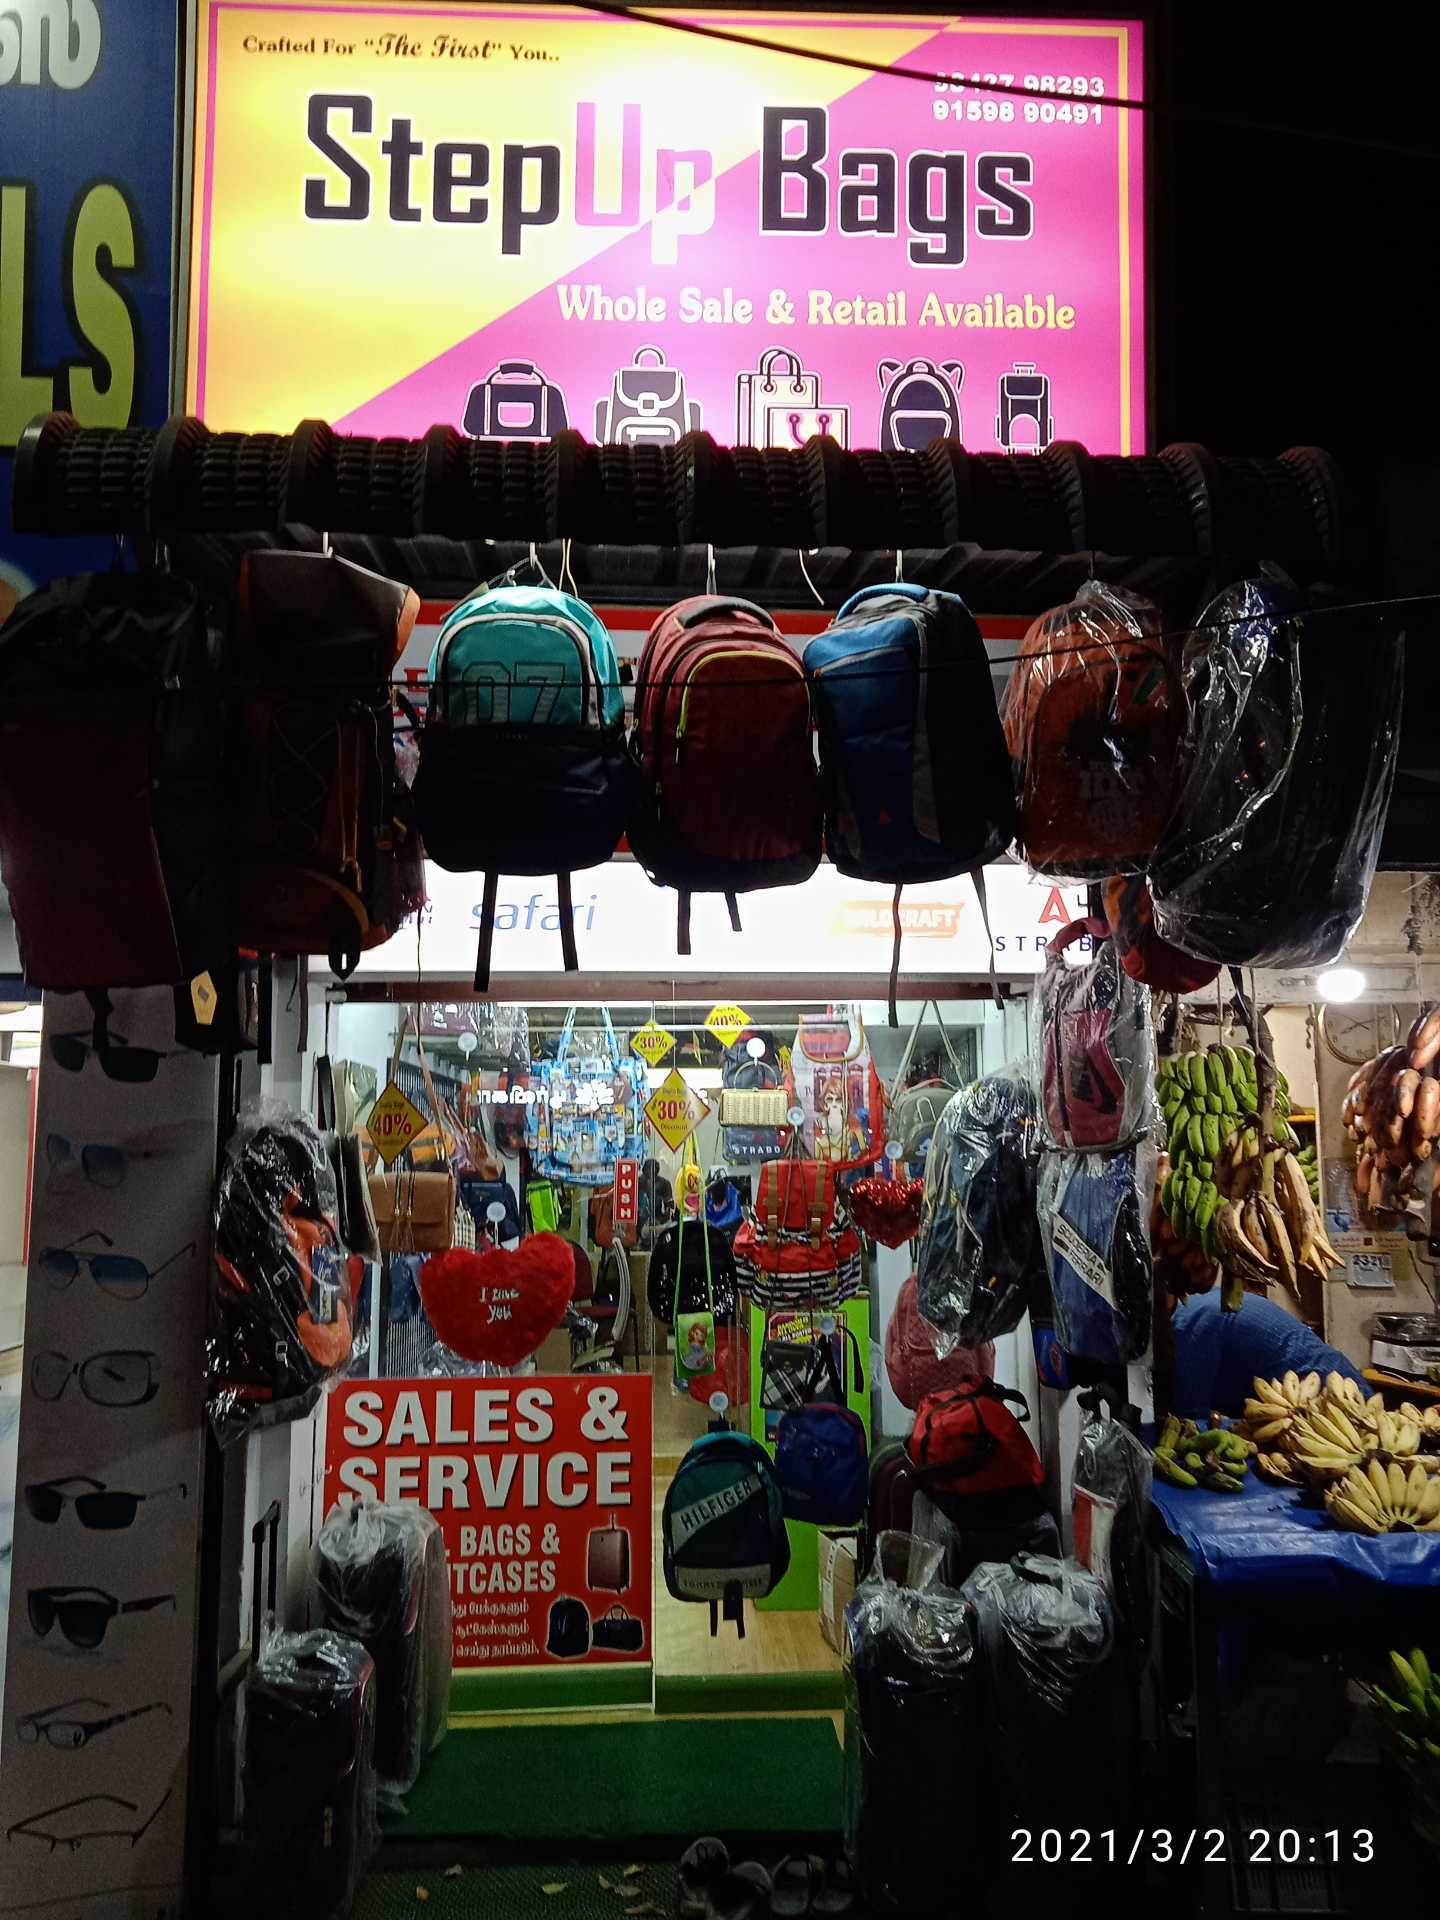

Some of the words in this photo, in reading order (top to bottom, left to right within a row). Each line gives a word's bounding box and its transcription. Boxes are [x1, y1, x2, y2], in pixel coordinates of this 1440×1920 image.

[242, 35, 315, 54] Crafted
[322, 38, 356, 56] For
[1023, 74, 1105, 98] 98293
[932, 99, 1016, 123] 91598
[1023, 102, 1103, 127] 90491
[761, 105, 1033, 267] Bags
[557, 283, 667, 322] Whole
[678, 286, 753, 324] Sale
[765, 288, 796, 325] &
[807, 289, 907, 327] Retail
[918, 292, 1077, 330] Available
[640, 1036, 668, 1049] 30%
[373, 1113, 412, 1137] 40%
[657, 1100, 695, 1121] 30%
[621, 1164, 632, 1219] PUSH
[486, 1304, 513, 1324] you
[343, 1387, 554, 1447] SALES
[580, 1386, 629, 1442] &
[337, 1451, 632, 1510] SERVICE
[680, 1478, 753, 1532] HILFIGER
[460, 1523, 532, 1557] BAGS
[540, 1522, 561, 1556] &
